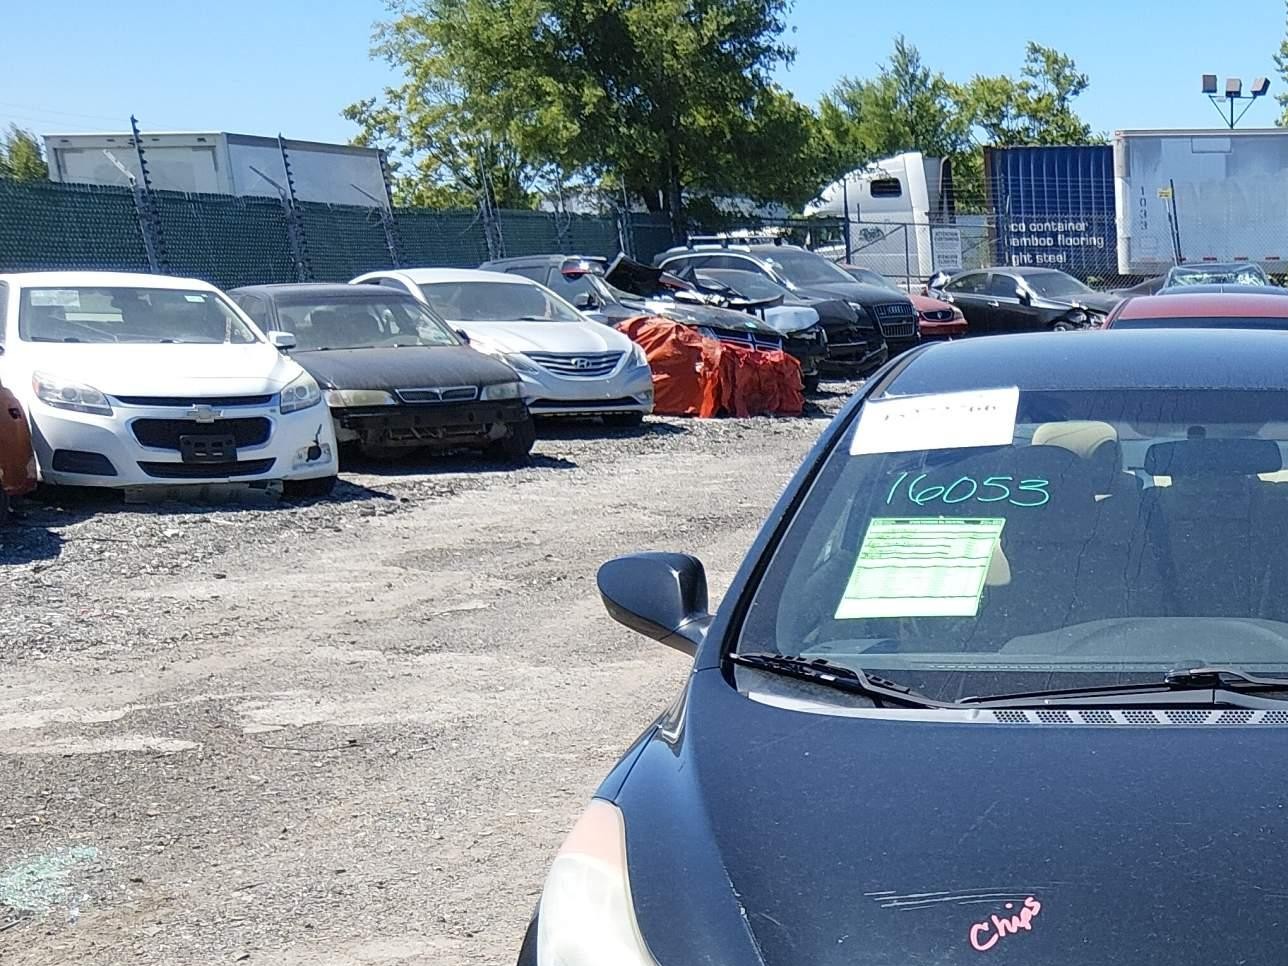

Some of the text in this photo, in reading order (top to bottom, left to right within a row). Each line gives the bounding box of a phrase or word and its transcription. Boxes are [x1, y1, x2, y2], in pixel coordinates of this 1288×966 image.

[1029, 220, 1088, 232] container
[1057, 234, 1105, 249] flooring
[1004, 251, 1067, 266] lght steel
[887, 472, 1050, 507] 16053
[970, 897, 1041, 951] Chips
